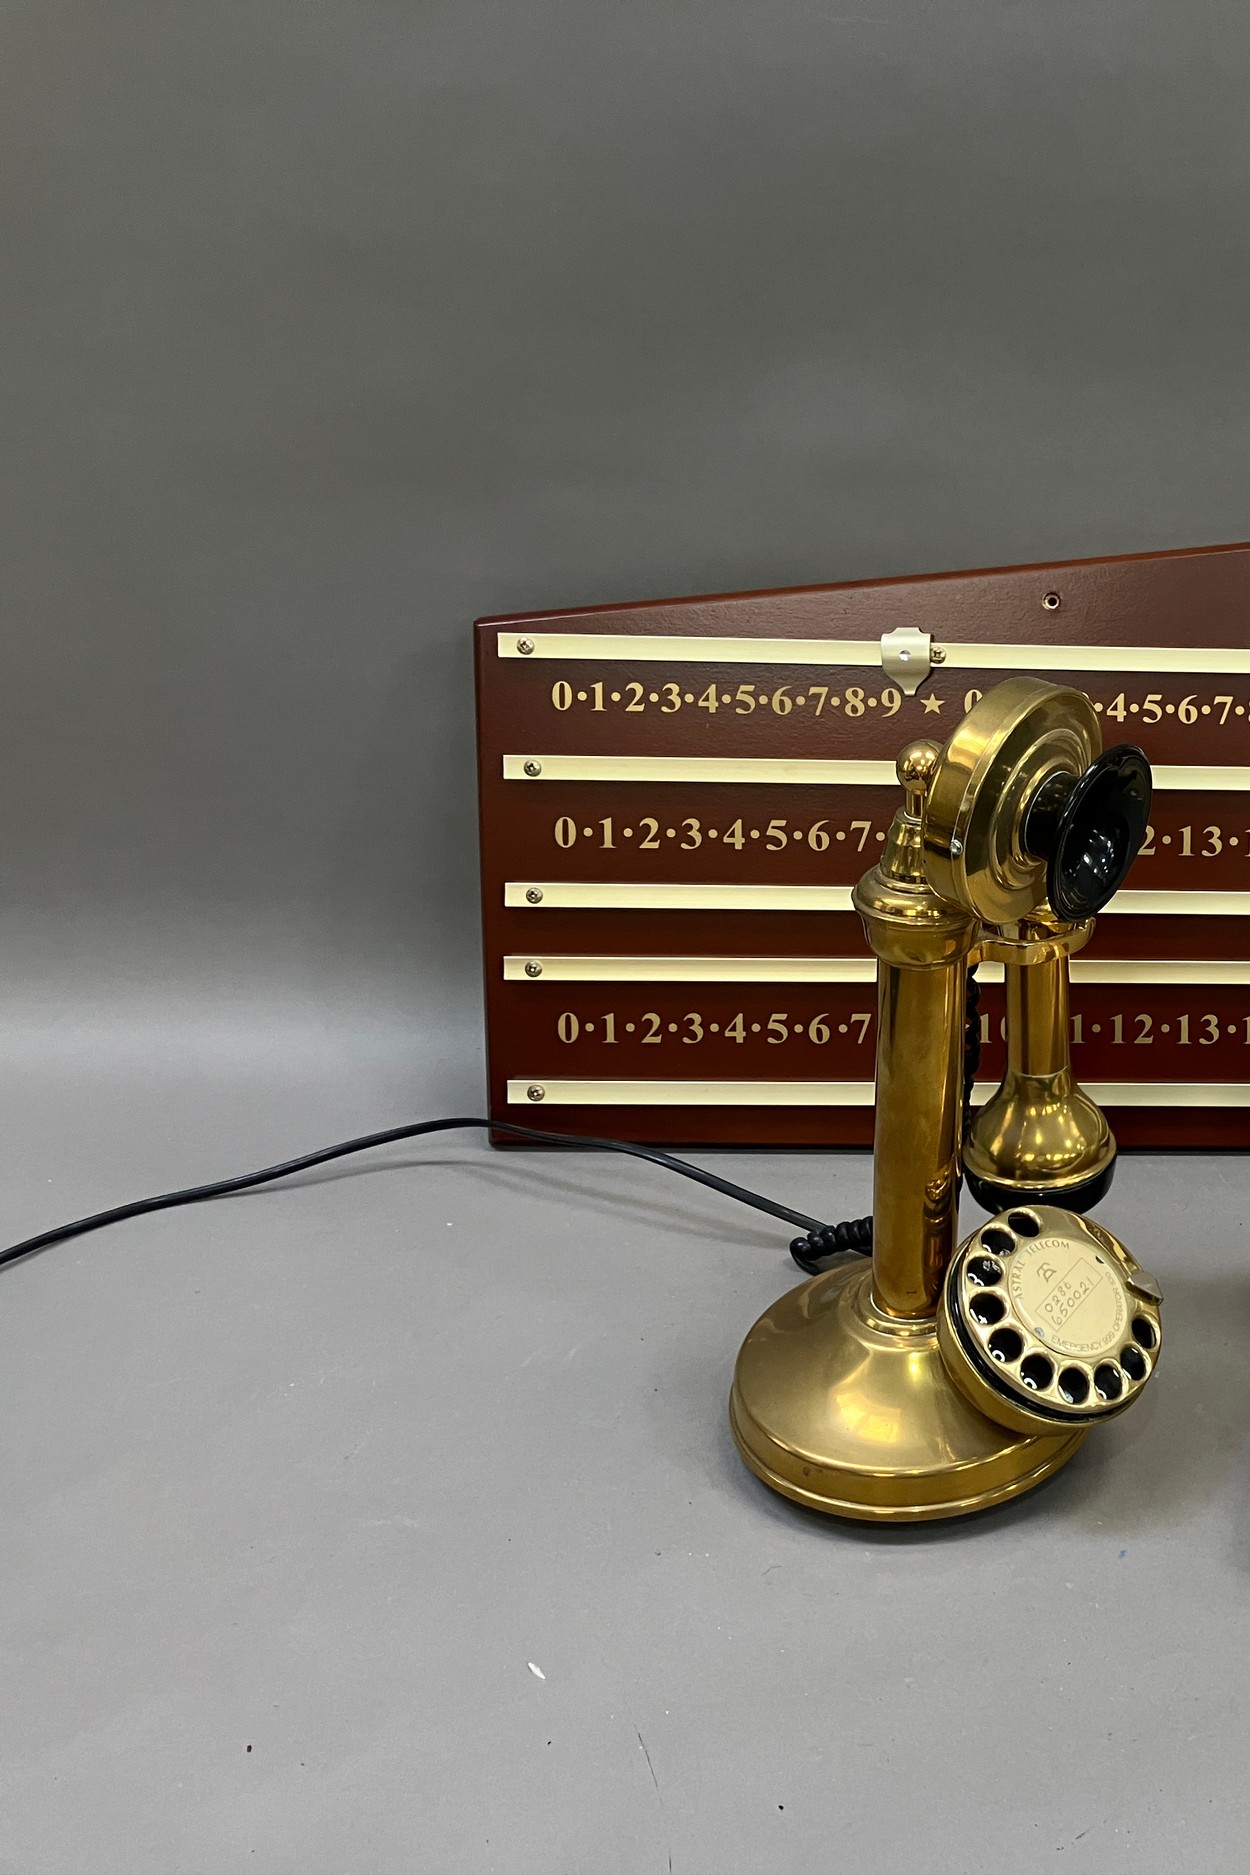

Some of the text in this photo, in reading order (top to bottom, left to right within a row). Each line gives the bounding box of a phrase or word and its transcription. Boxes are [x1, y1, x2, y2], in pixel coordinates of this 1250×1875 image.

[1012, 1239, 1070, 1300] ASTRAL TELECOM
[1051, 1334, 1102, 1352] EMERGENCY
[1102, 1330, 1115, 1344] 999
[1113, 1287, 1123, 1331] OPERATOR
